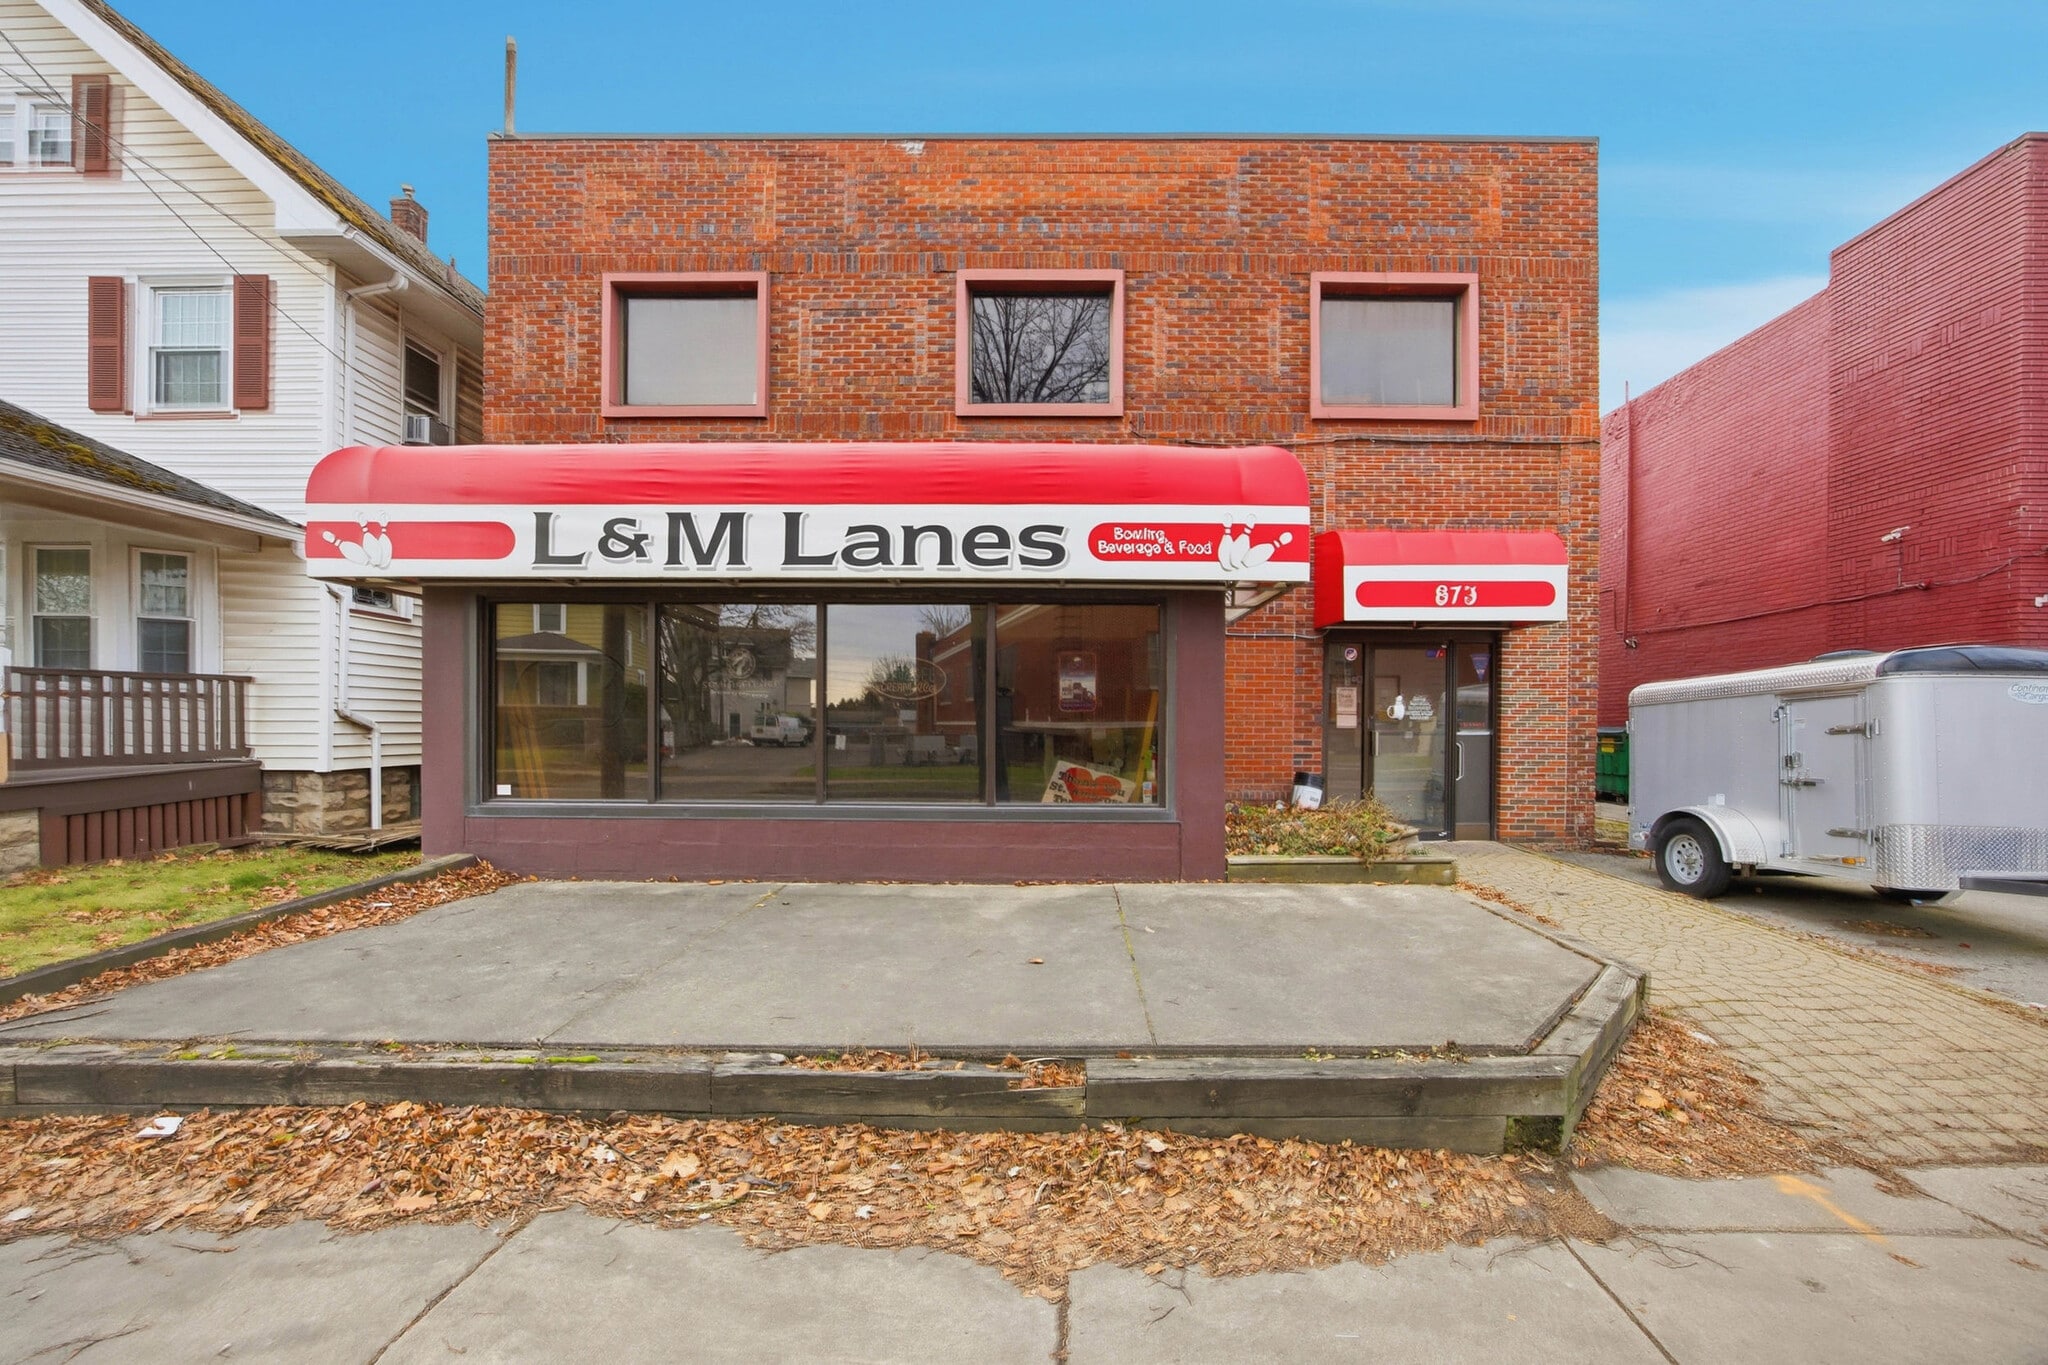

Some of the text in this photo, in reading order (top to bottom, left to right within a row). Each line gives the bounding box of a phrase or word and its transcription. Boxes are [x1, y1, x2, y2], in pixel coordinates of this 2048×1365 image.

[781, 511, 1067, 568] Lanes
[1114, 527, 1165, 544] Bowling
[1178, 540, 1212, 555] Food
[1435, 584, 1477, 606] 873
